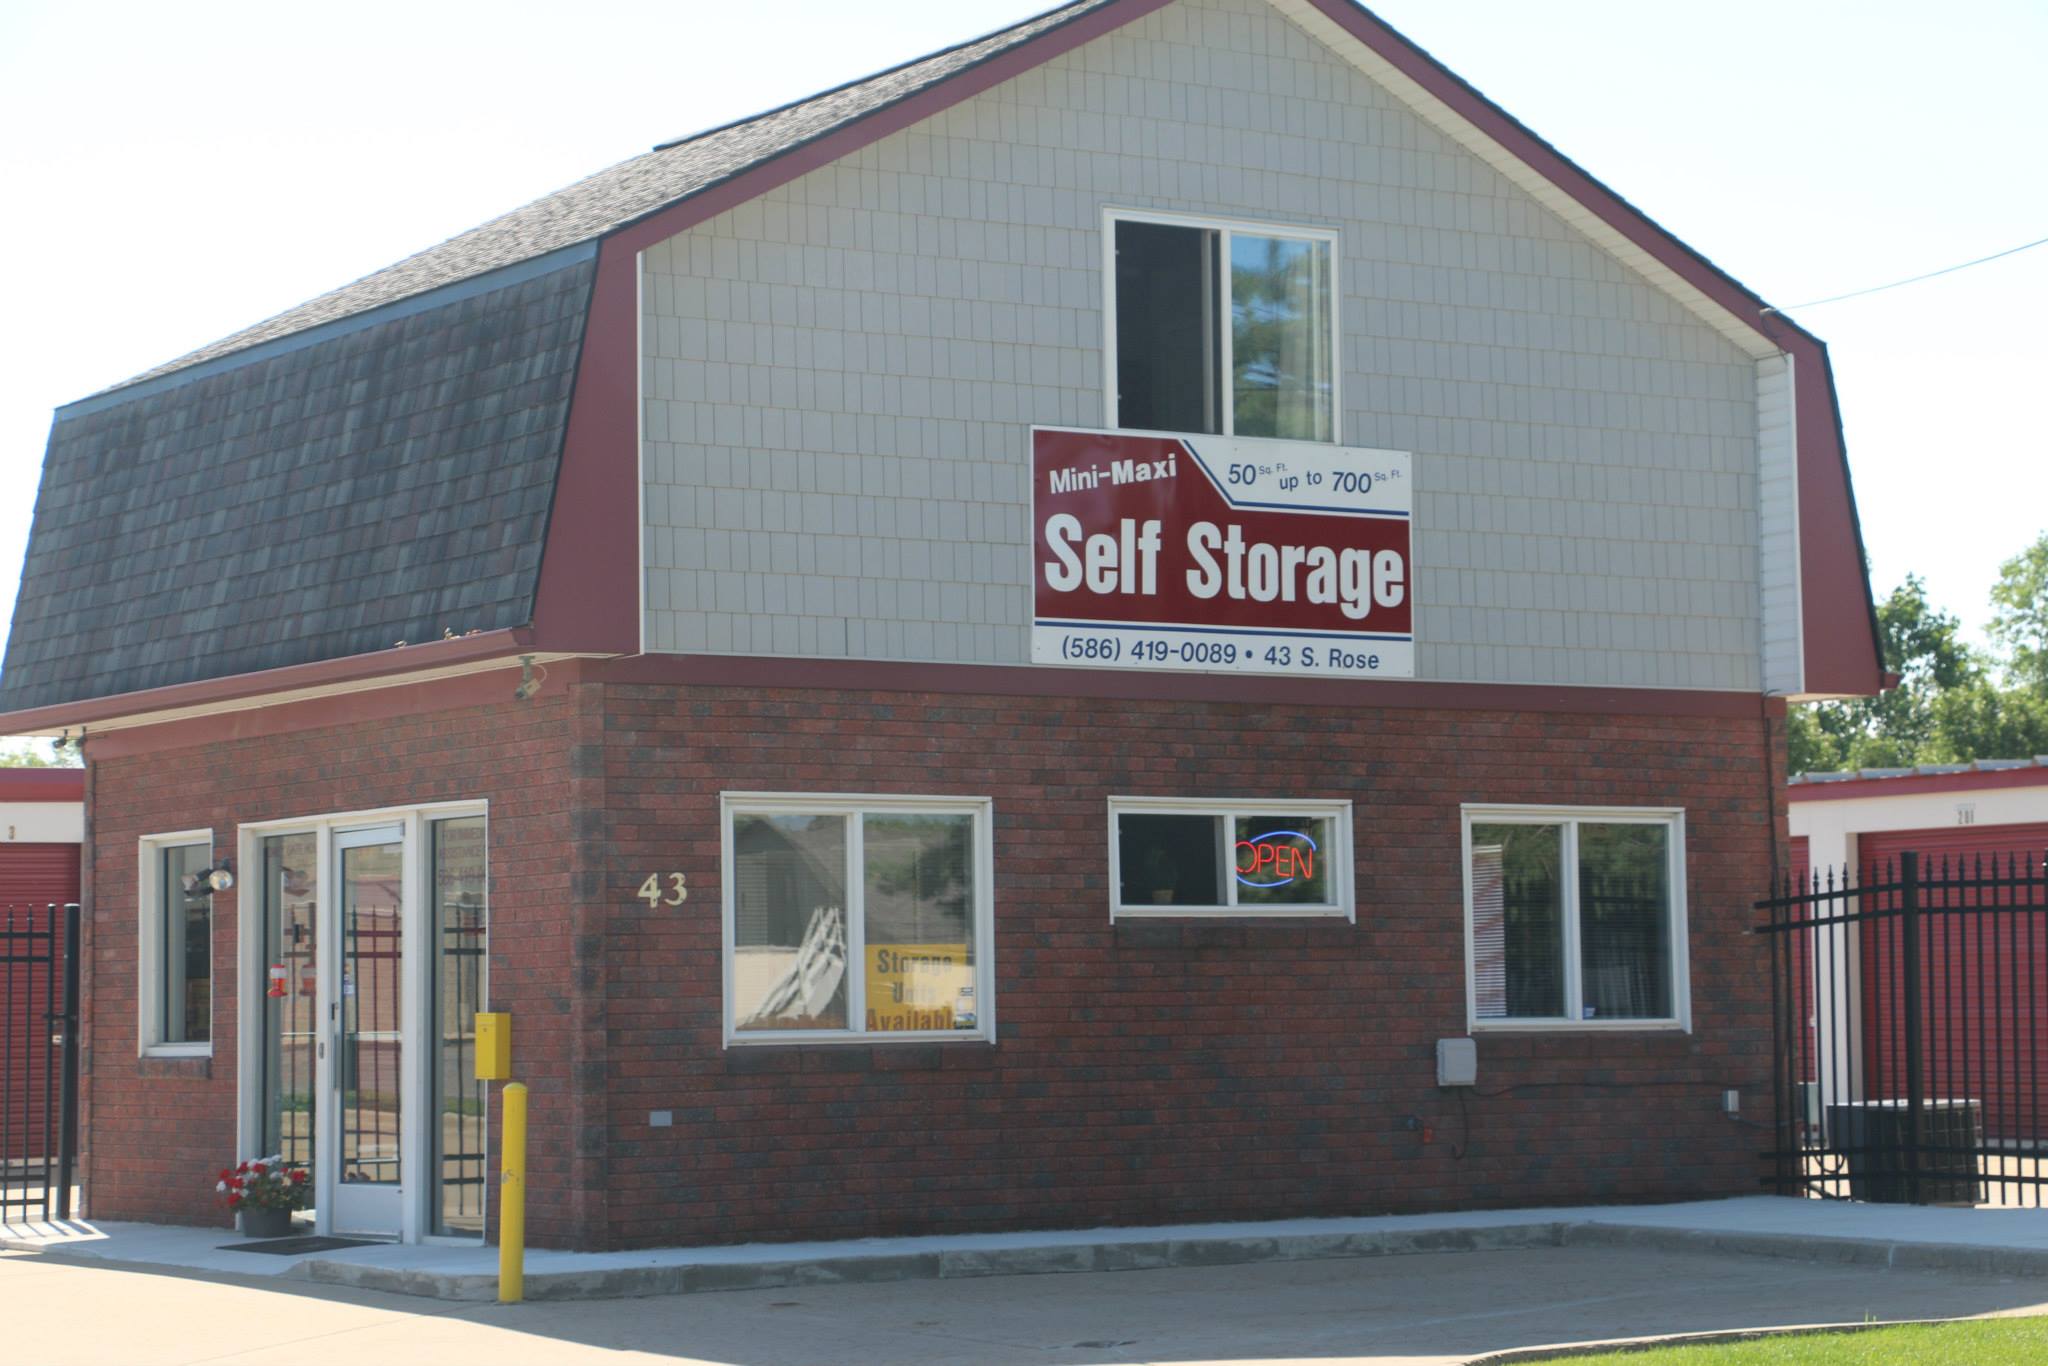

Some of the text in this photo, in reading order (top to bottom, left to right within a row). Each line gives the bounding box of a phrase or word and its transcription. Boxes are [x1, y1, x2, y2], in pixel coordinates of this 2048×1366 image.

[1049, 452, 1177, 495] Mini-Maxi
[1227, 463, 1257, 486] 50
[1279, 475, 1299, 492] up
[1306, 469, 1323, 486] to
[1331, 471, 1372, 494] 700
[1044, 513, 1405, 620] Self Storage
[1061, 635, 1380, 670] (586) 419-0089 43 S. Rose
[1234, 841, 1313, 879] OPEN
[637, 872, 688, 908] 43
[865, 1008, 956, 1031] Availabl
